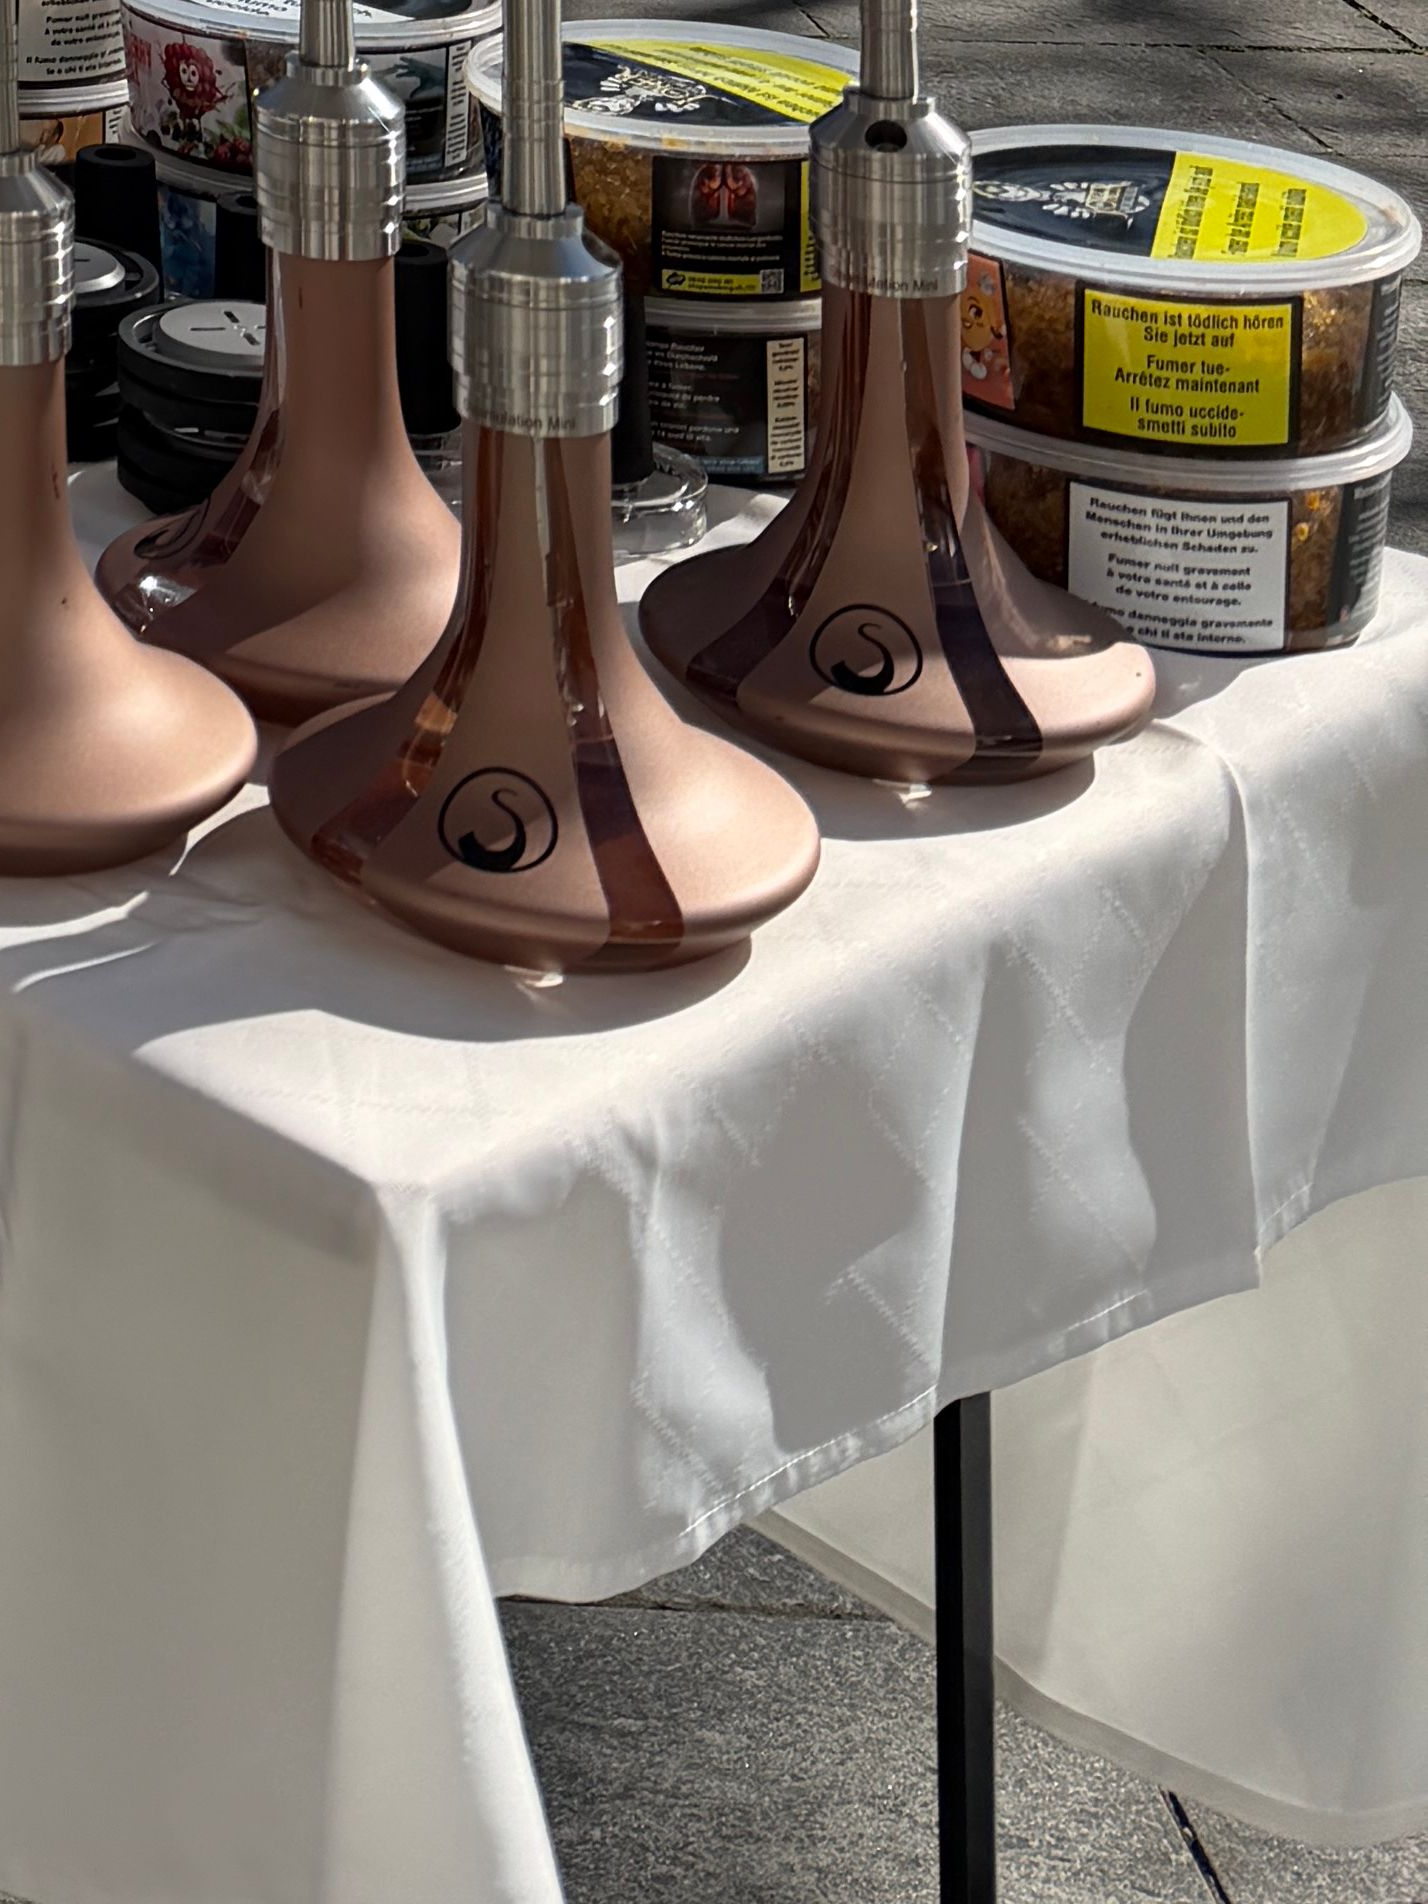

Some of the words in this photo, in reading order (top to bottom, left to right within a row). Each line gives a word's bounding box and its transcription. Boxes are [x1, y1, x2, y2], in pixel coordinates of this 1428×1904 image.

[1091, 299, 1158, 324] Rauchen
[1163, 311, 1182, 326] ist
[1187, 312, 1238, 330] tödlich
[1243, 314, 1284, 330] hören
[1144, 326, 1168, 342] Sie
[1173, 329, 1205, 347] jetzt
[1211, 333, 1235, 347] auf
[1147, 355, 1196, 374] Fumer
[1200, 361, 1230, 375] tue-
[1114, 367, 1170, 390] Arrêtez
[1175, 377, 1260, 394] maintenant
[1130, 396, 1139, 412] Il
[1145, 397, 1183, 418] fumo
[1189, 404, 1245, 420] uccide-
[548, 415, 577, 430] Mini
[1137, 418, 1186, 436] smetti
[1191, 422, 1236, 438] subito
[1090, 497, 1147, 517] Rauchen
[1151, 507, 1177, 522] fügt
[1181, 510, 1217, 524] Ihnen
[1220, 513, 1244, 524] und
[1247, 513, 1270, 524] den
[1085, 511, 1151, 532] Menschen
[1171, 525, 1203, 539] Ihrer
[1207, 527, 1273, 541] Umgebung
[1100, 530, 1179, 550] erheblichen
[1182, 541, 1238, 554] Schaden
[1107, 553, 1151, 570] Fumer
[1183, 565, 1251, 577] gravement
[1115, 584, 1132, 596] de
[1136, 586, 1170, 602] votre
[1118, 570, 1152, 584] votre
[1155, 575, 1191, 589] santé
[1222, 580, 1252, 592] celle
[1128, 605, 1198, 628] danneggia
[1201, 618, 1273, 629] gravemente
